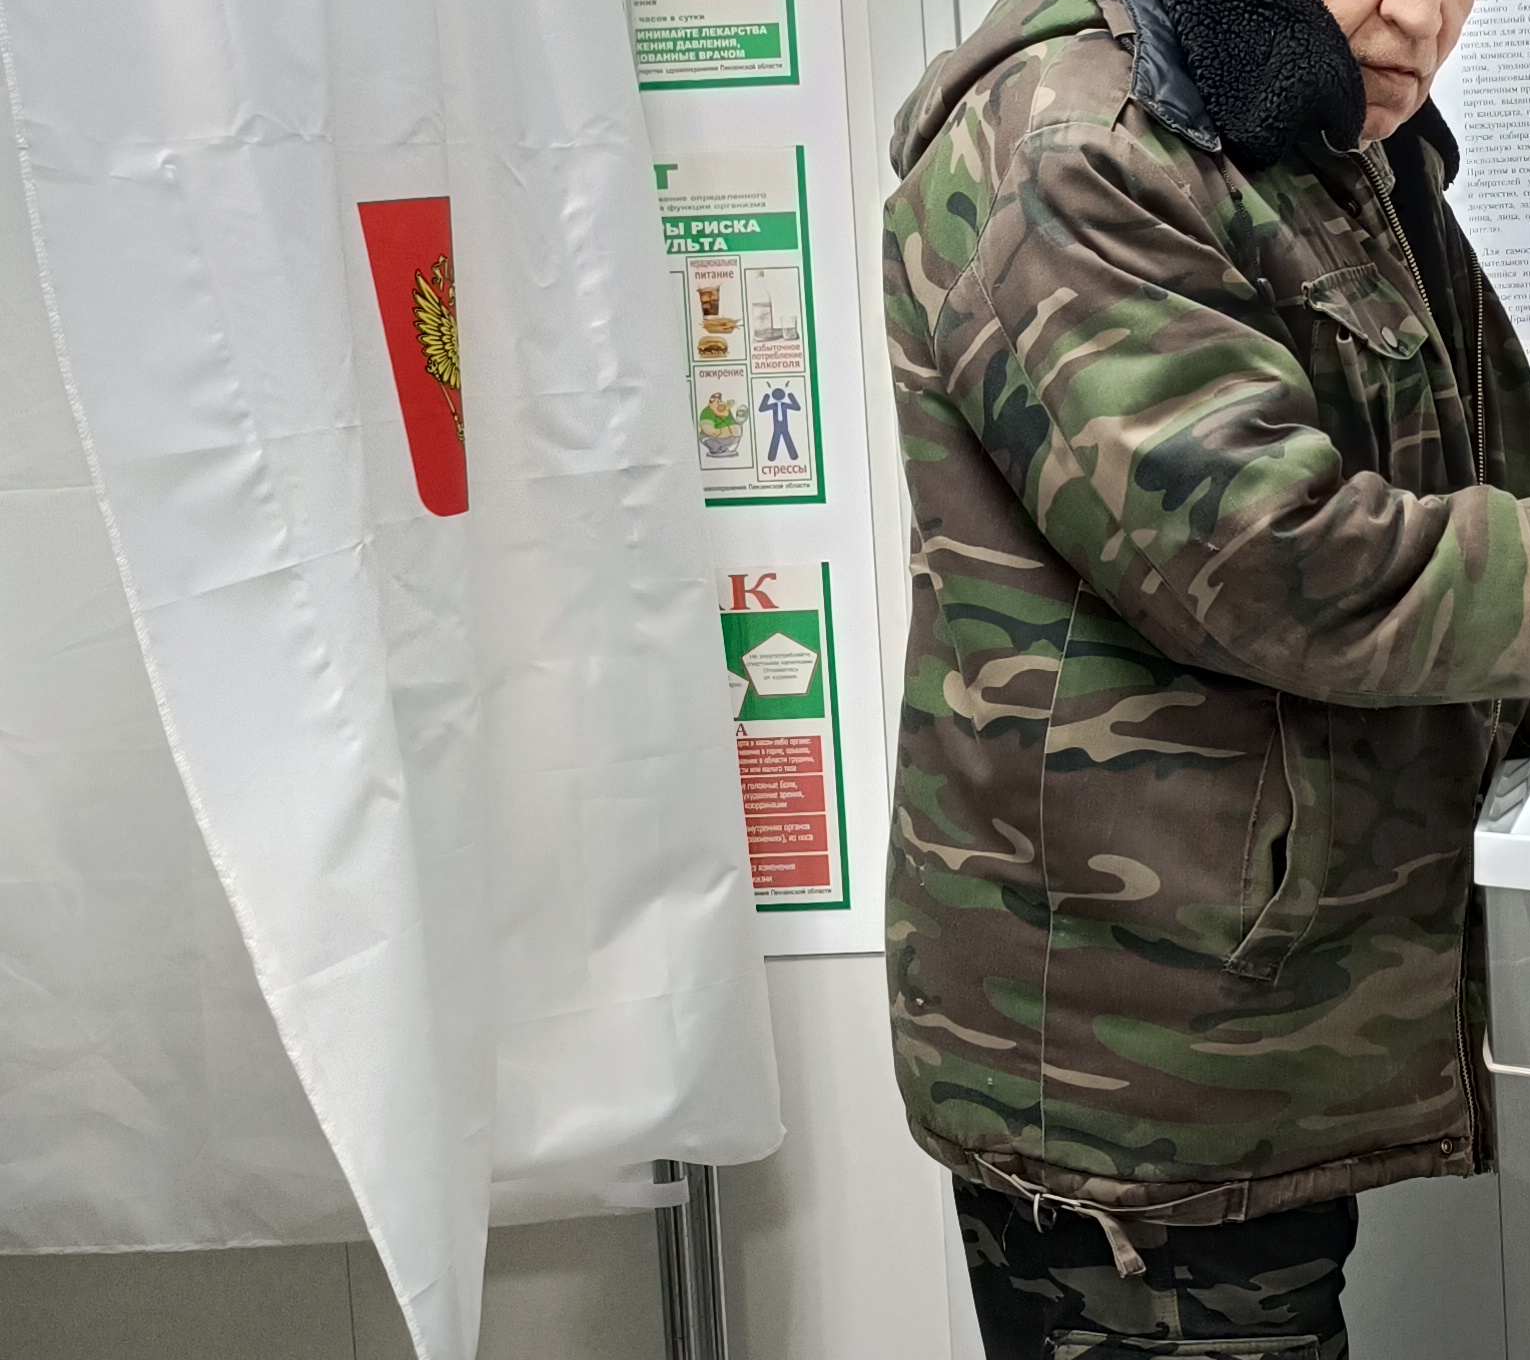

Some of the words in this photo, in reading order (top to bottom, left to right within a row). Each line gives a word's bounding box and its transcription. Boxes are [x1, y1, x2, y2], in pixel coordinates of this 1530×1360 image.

[679, 14, 705, 22] сутки
[702, 25, 767, 37] ЛЕКАРСТВА
[676, 38, 740, 50] ДАВЛЕНИЯ,
[699, 49, 745, 60] ВРАЧОМ
[691, 192, 767, 202] определенного
[668, 203, 711, 212] функции
[714, 202, 766, 210] организма
[691, 219, 761, 235] РИСКА
[695, 270, 735, 281] питание
[754, 343, 800, 352] избыточное
[754, 360, 800, 369] алкоголя
[699, 369, 744, 379] ожирение
[761, 464, 807, 477] стрессы
